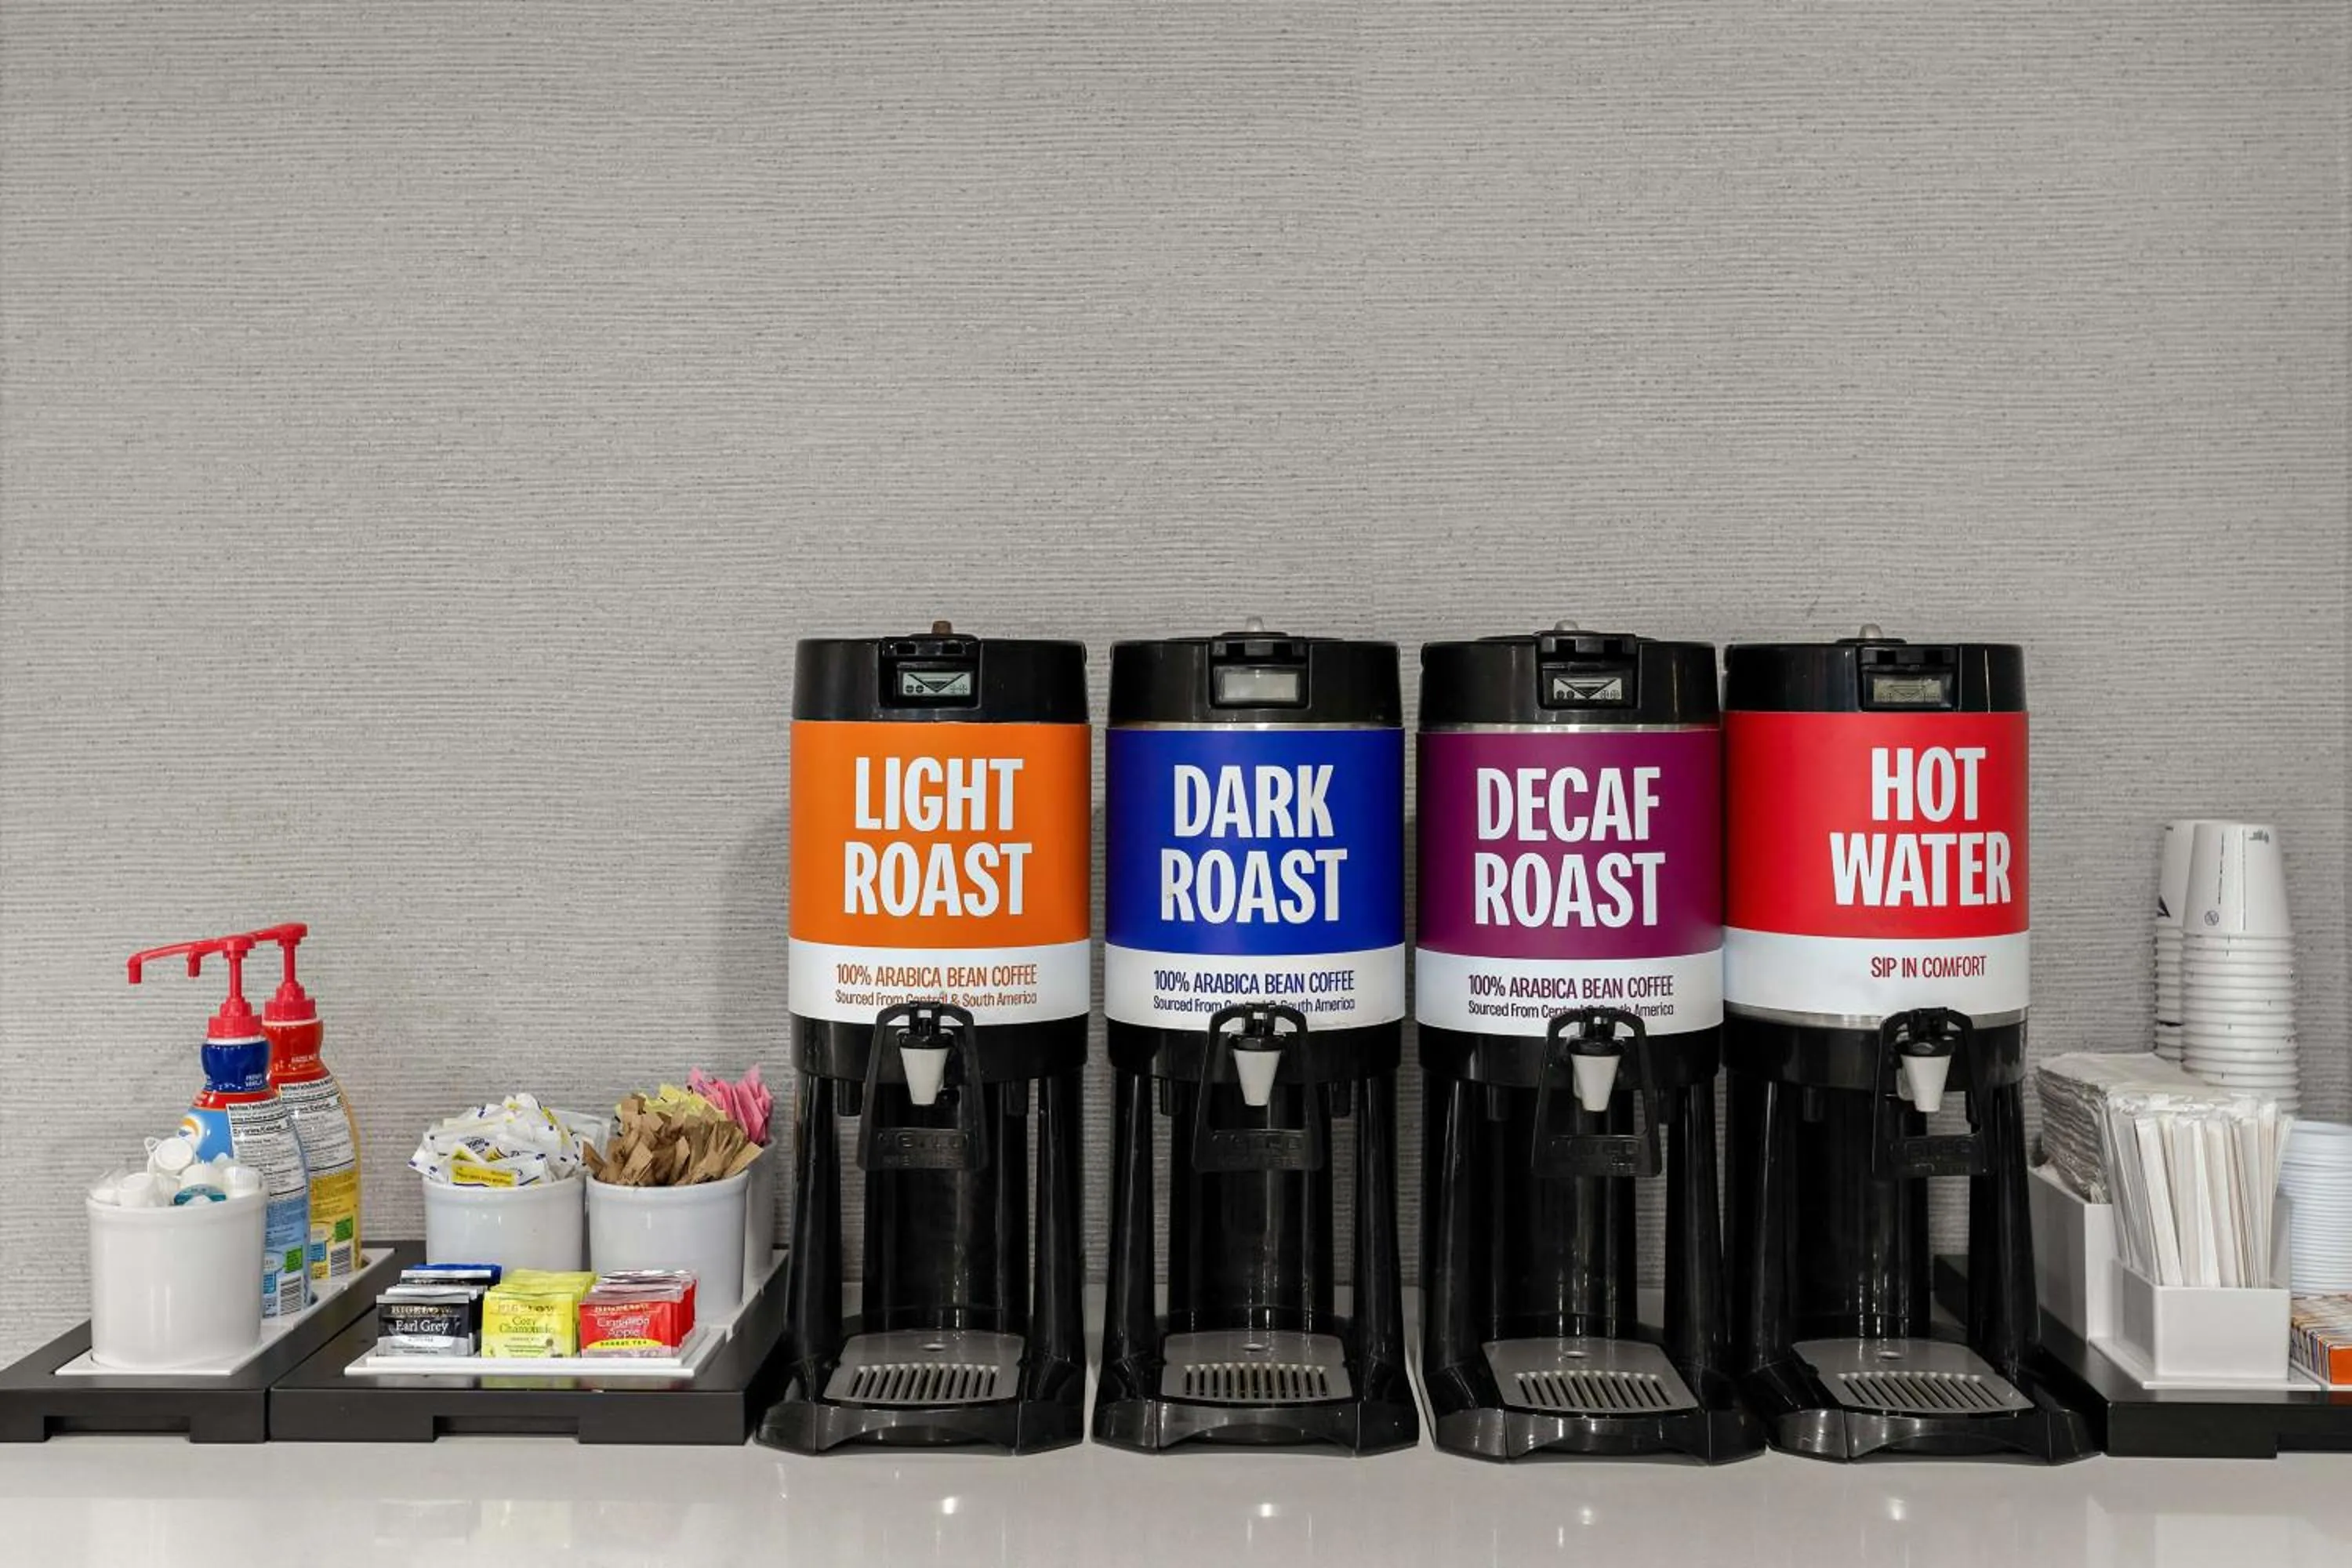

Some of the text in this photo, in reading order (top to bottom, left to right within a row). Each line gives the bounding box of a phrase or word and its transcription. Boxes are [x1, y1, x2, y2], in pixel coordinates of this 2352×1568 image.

[855, 757, 1023, 832] LIGHT
[1174, 764, 1334, 838] DARK
[1477, 767, 1661, 841] DECAF
[1872, 747, 1986, 822] HOT
[844, 842, 1033, 916] ROAST
[1161, 848, 1347, 924] ROAST
[1475, 852, 1665, 927] ROAST
[1830, 832, 2011, 906] WATER
[836, 964, 1037, 988] 100% ARABICA BEAN COFFEE
[1153, 970, 1355, 994] 100% ARABICA BEAN COFFEE
[1468, 975, 1674, 999] 100% ARABICA BEAN COFFEE
[1871, 955, 1987, 978] SIP IN COMFORT
[836, 989, 874, 1006] Sourced
[877, 992, 903, 1006] From
[962, 993, 996, 1007] South
[998, 991, 1037, 1006] America
[1153, 995, 1192, 1012] Sourced
[1194, 998, 1221, 1013] From
[1315, 997, 1356, 1012] America
[1468, 1000, 1508, 1017] Sourced
[1511, 1003, 1539, 1018] From
[1635, 1002, 1674, 1017] America
[395, 1319, 449, 1335] Earl Grey
